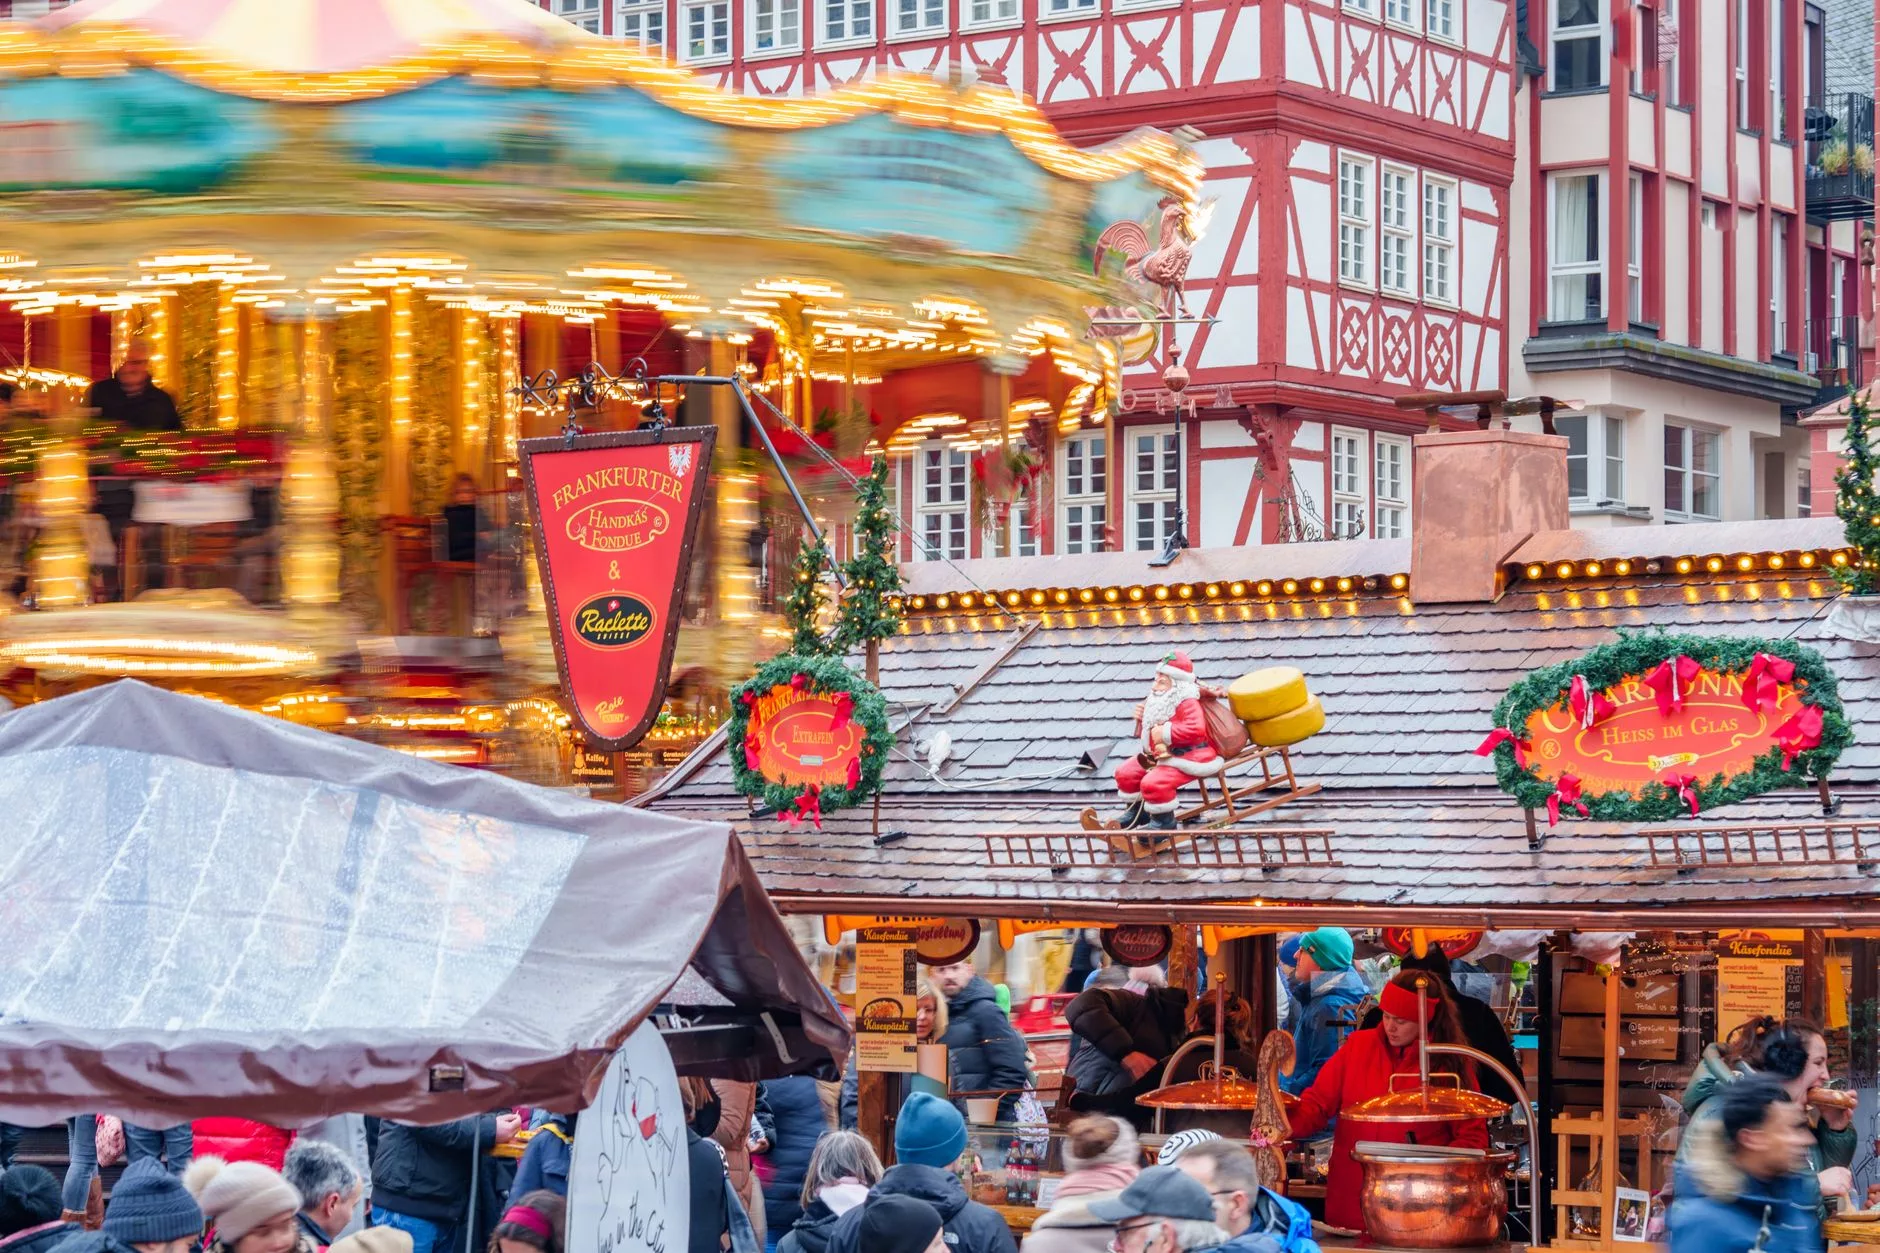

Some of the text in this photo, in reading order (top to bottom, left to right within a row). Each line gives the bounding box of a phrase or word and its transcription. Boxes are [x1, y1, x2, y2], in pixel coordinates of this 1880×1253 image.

[552, 467, 682, 511] FRANKFURTER
[592, 530, 641, 549] FONDUE
[608, 560, 621, 580] &
[580, 609, 648, 633] Raclette
[792, 725, 834, 745] EXTRAFEIN
[1601, 717, 1739, 746] HEISS IM GLAS
[628, 1190, 644, 1240] the
